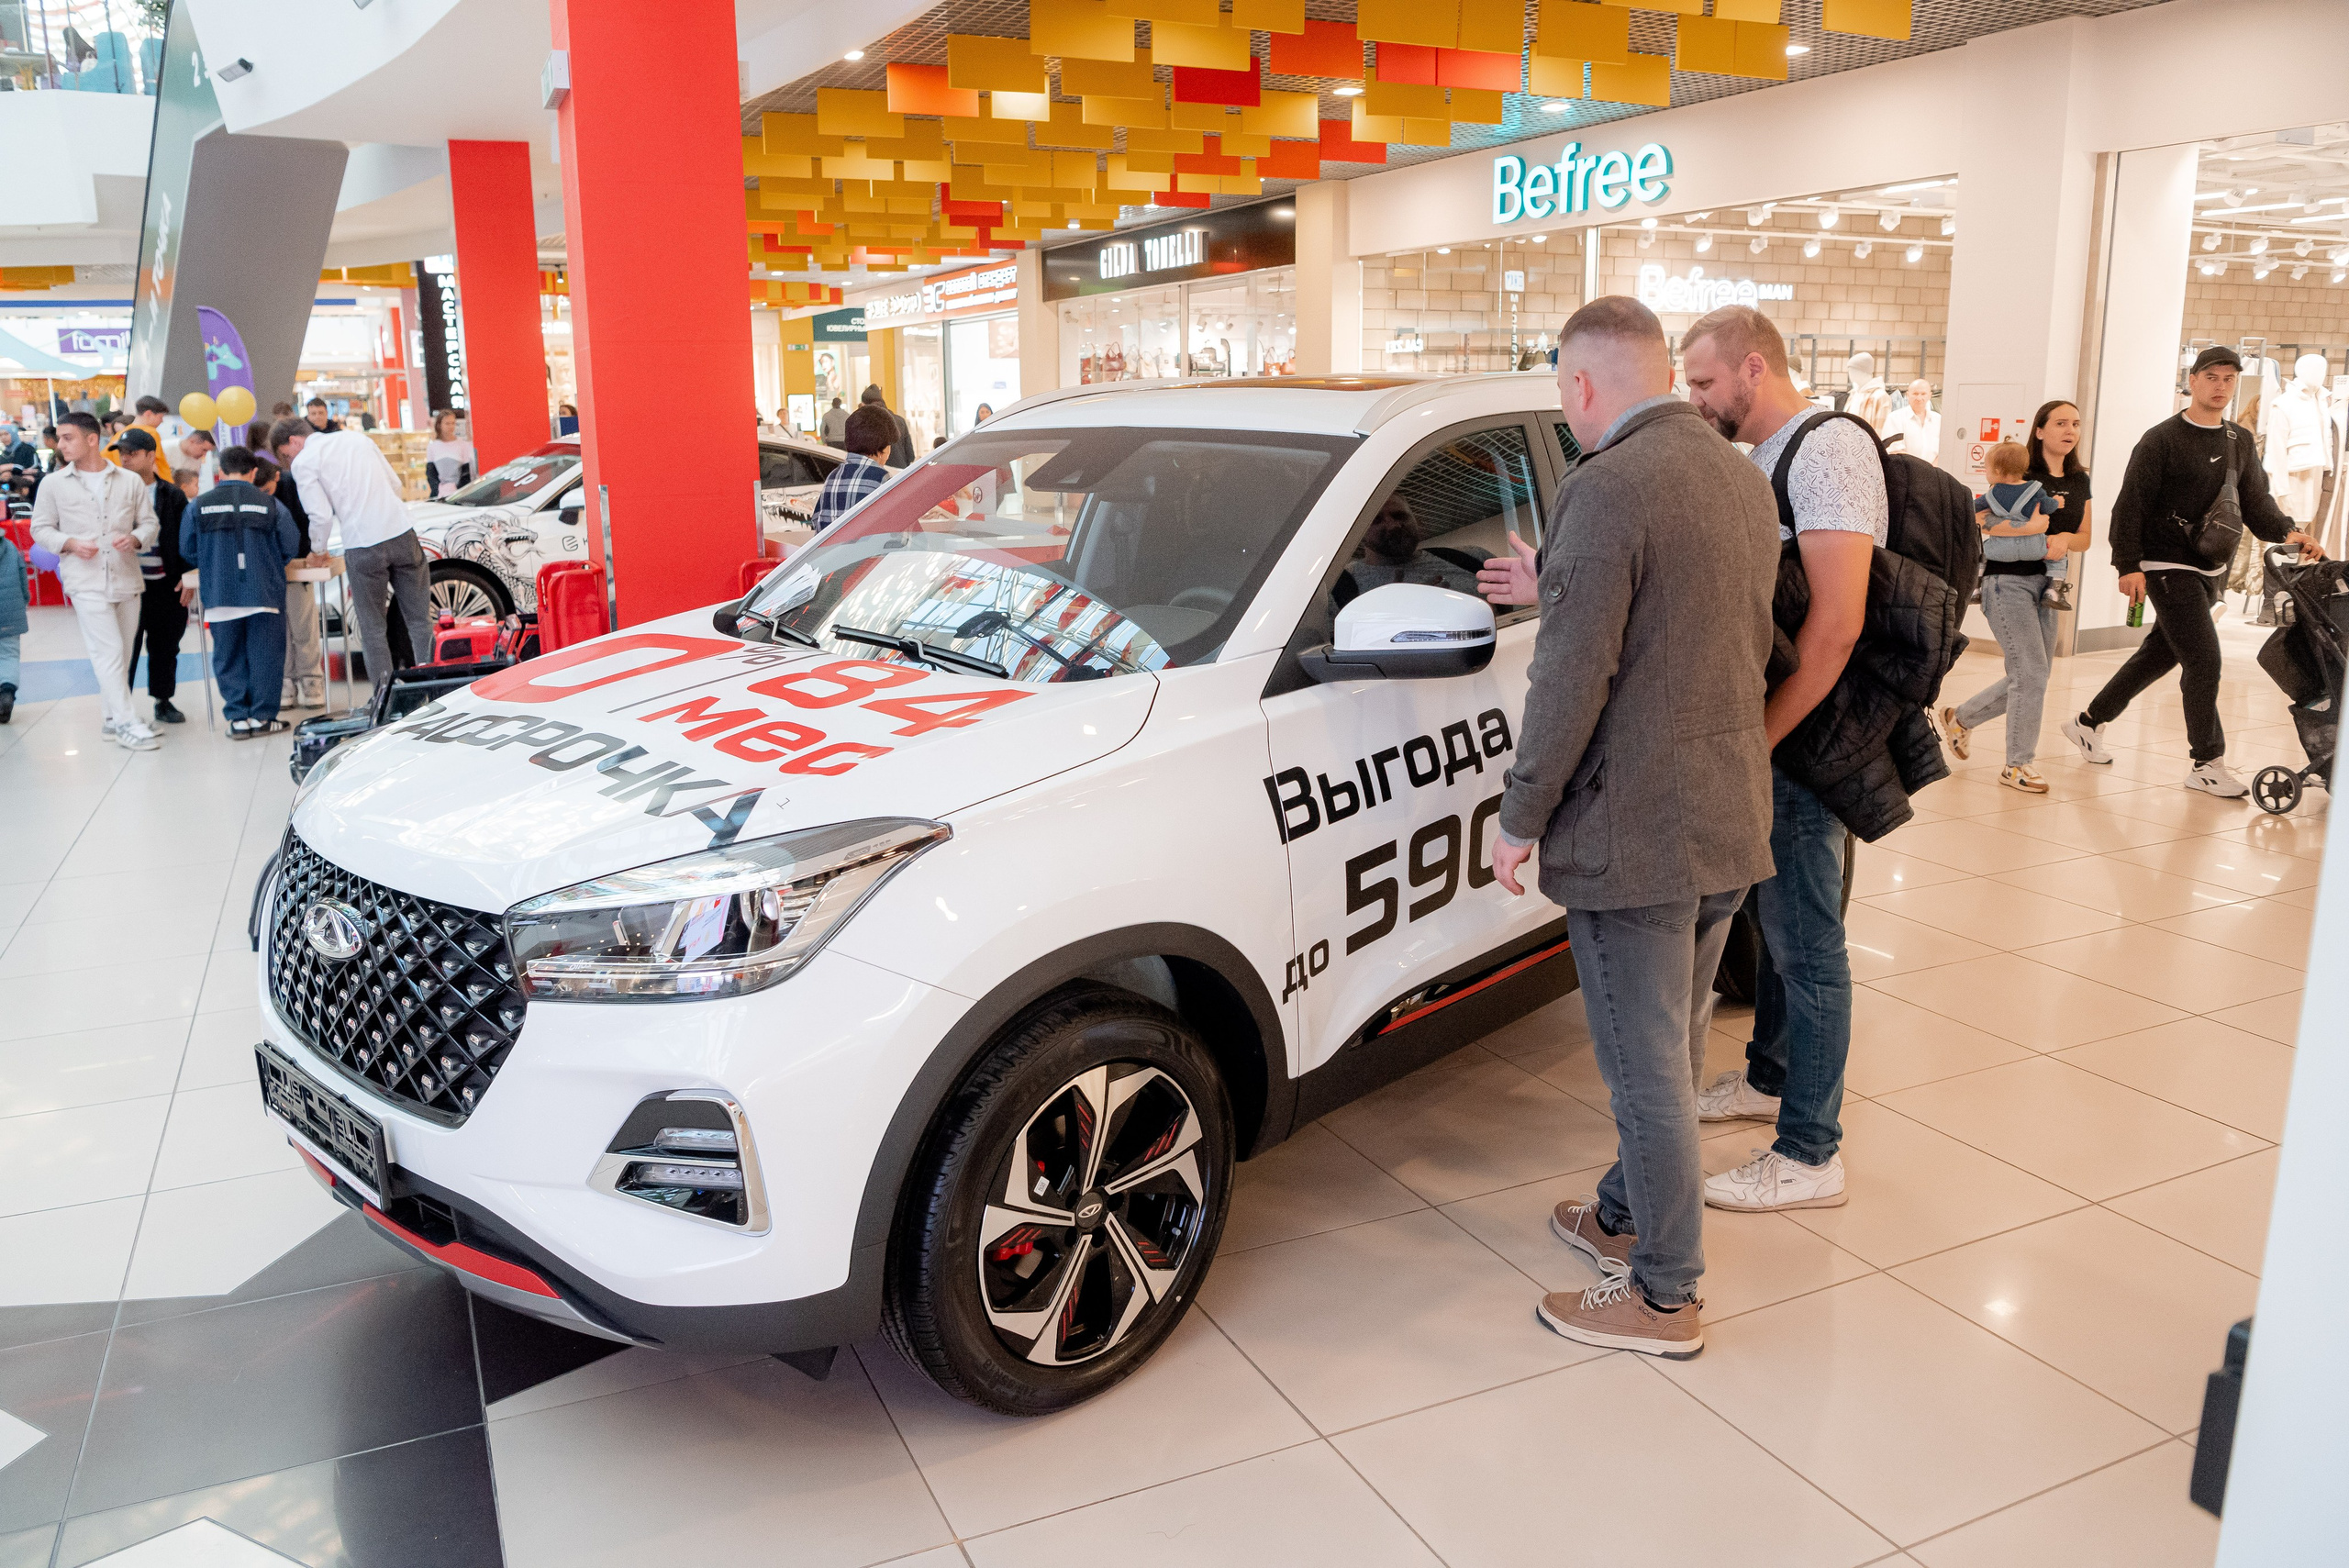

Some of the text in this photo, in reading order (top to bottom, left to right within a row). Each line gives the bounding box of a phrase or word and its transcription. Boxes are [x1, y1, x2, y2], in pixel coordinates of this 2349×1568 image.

[1492, 141, 1674, 225] Befree
[1099, 242, 1137, 279] GILDA
[1639, 264, 1794, 312] Befree MAN
[437, 274, 464, 409] МАСТЕРСКАЯ
[638, 695, 895, 777] мес
[747, 659, 1038, 737] 84
[390, 701, 765, 849] РАССРОЧКУ
[1263, 707, 1514, 846] Выгода
[1282, 938, 1330, 1005] до
